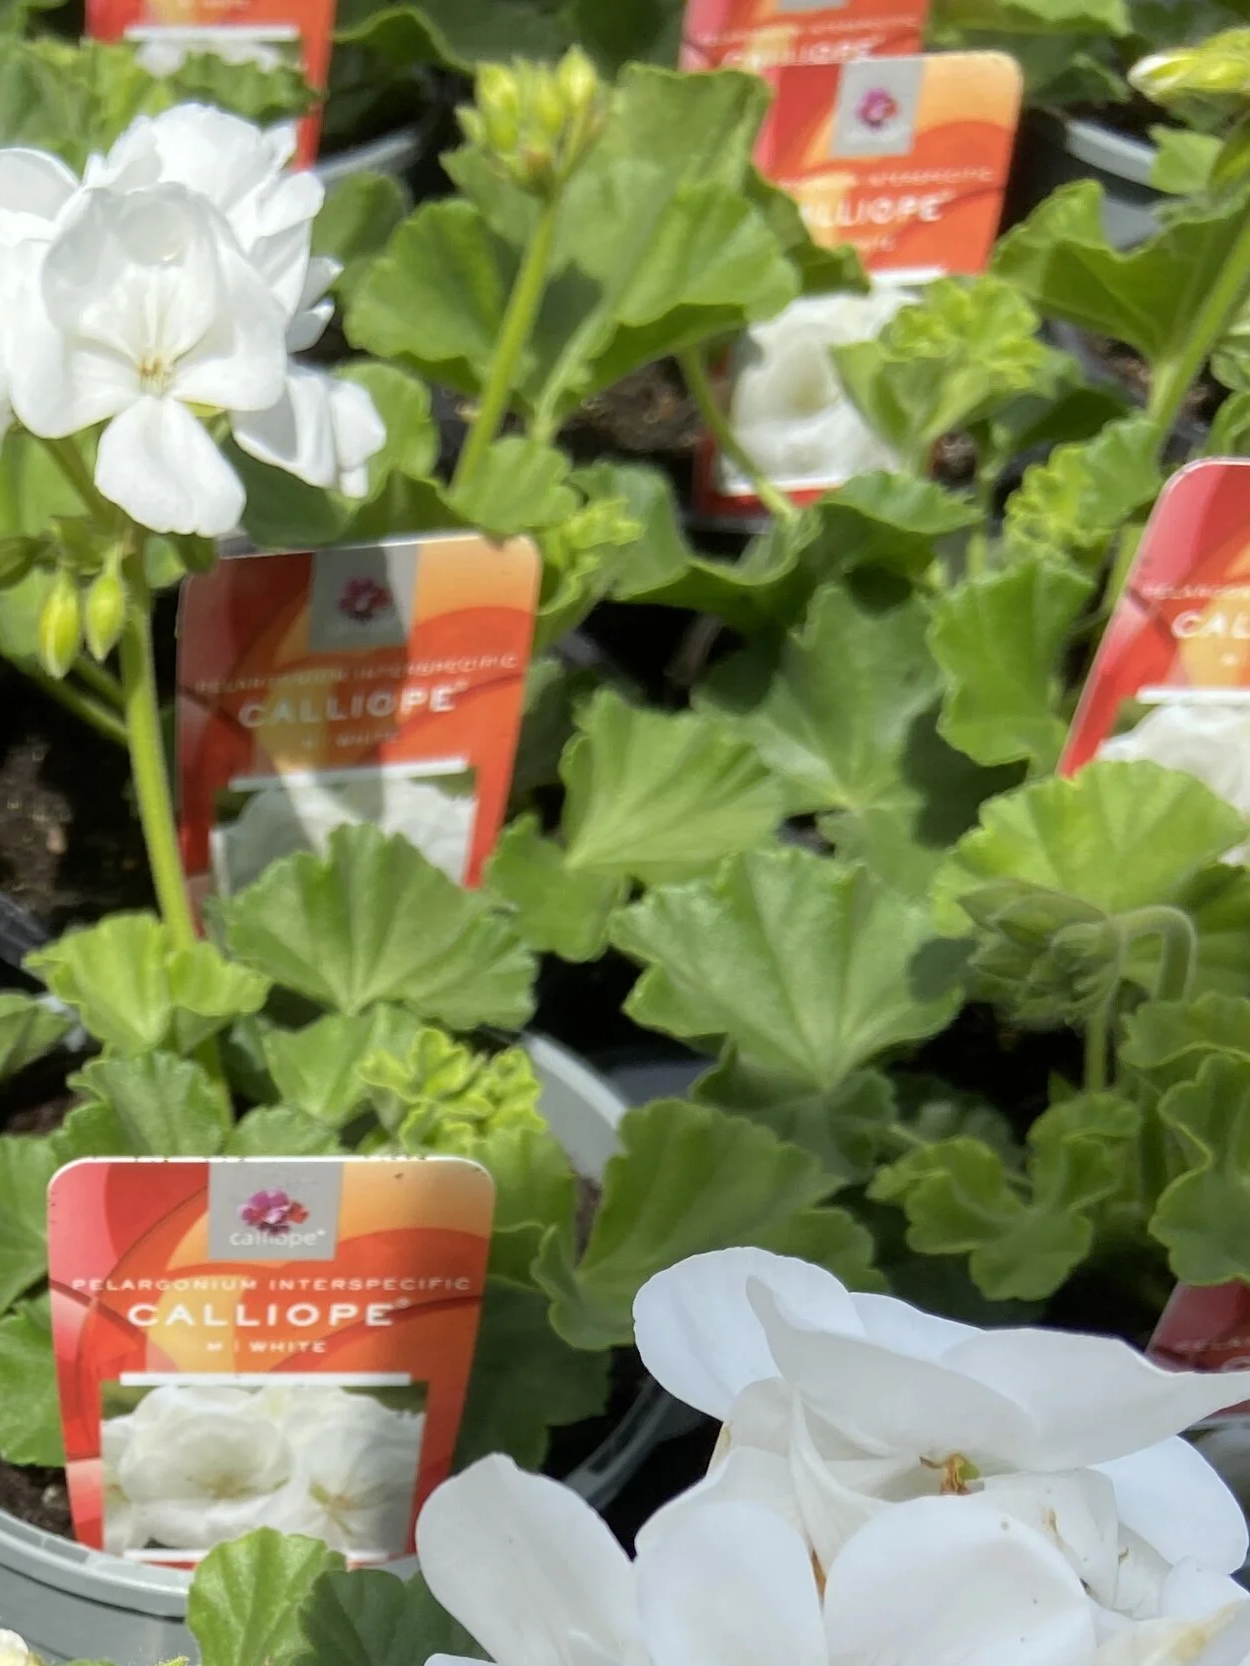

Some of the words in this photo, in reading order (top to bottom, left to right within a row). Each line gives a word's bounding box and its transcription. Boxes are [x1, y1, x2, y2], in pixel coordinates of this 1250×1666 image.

[71, 1277, 257, 1292] PELARGONIUM
[268, 1276, 471, 1292] INTERSPECIFIC
[249, 1340, 327, 1354] WHITE
